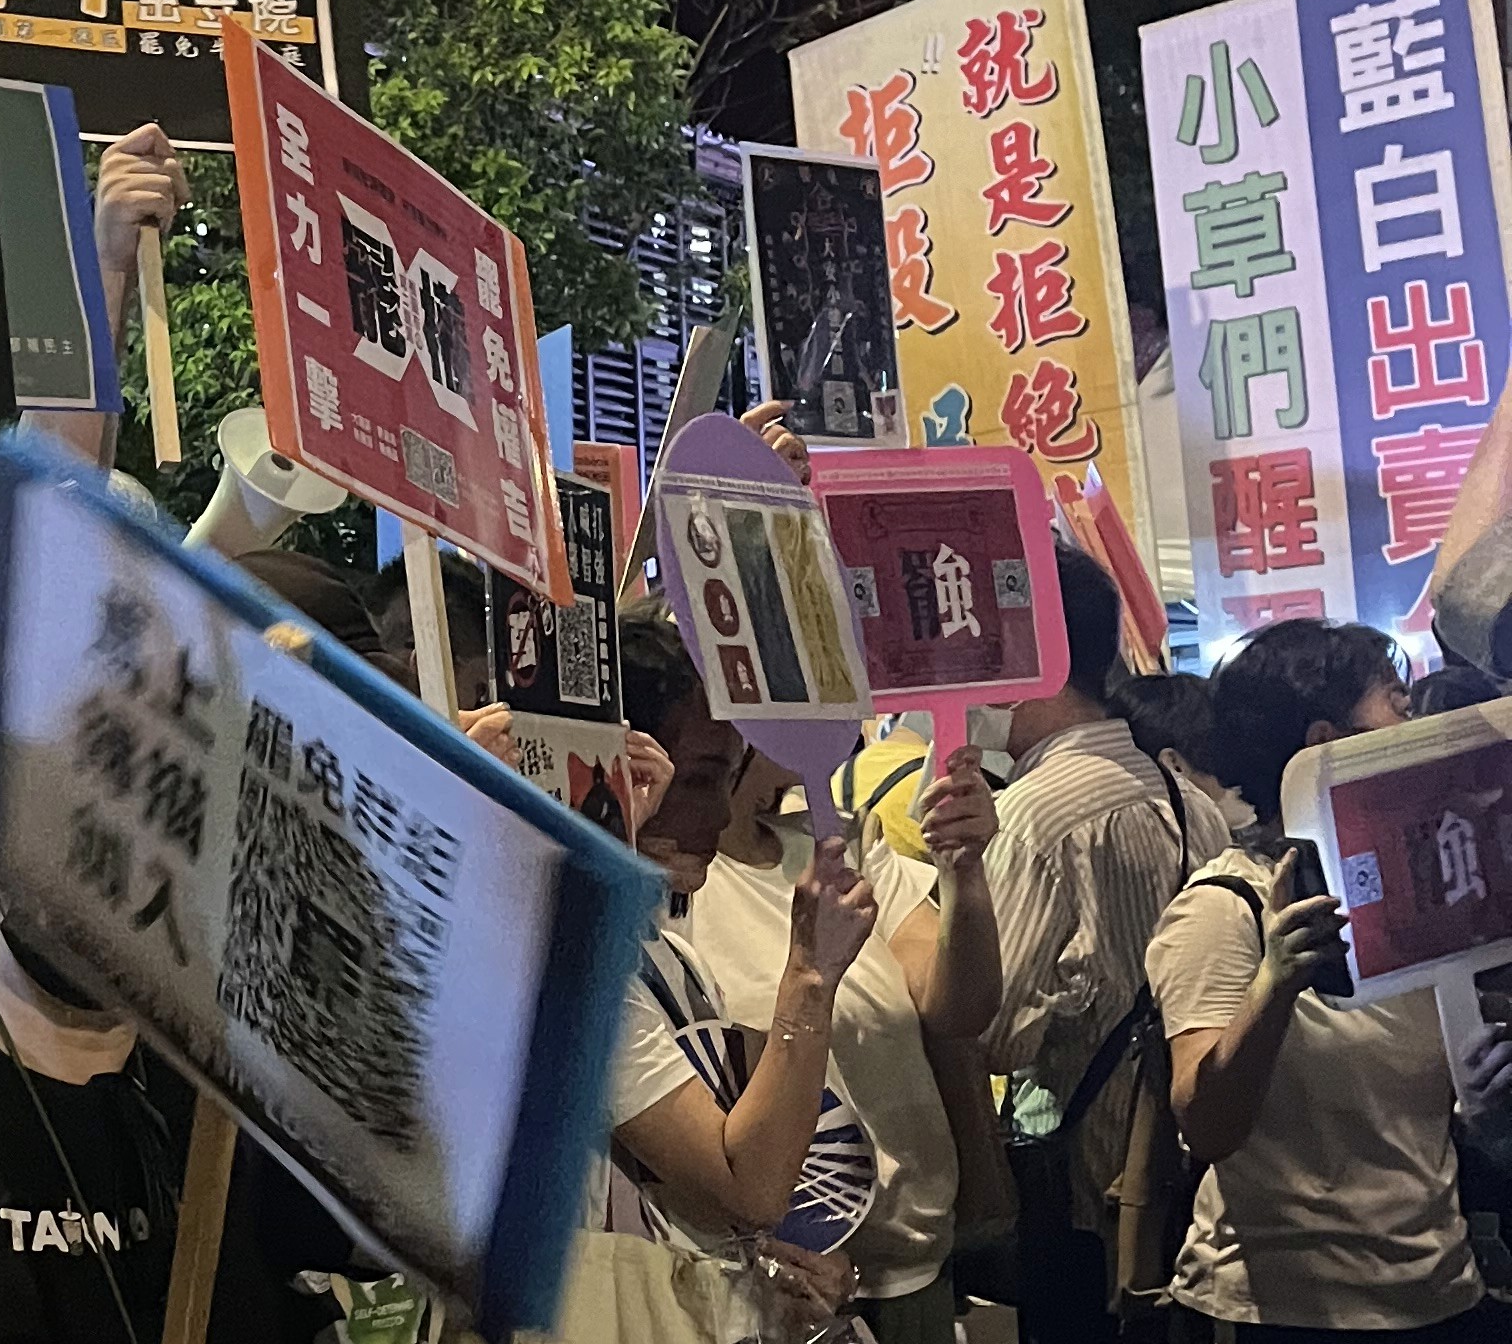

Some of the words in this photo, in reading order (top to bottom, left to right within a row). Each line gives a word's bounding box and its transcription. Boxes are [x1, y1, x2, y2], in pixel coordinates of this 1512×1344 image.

[139, 31, 306, 67] 罷免牛庭
[957, 8, 1100, 504] 就是拒絕
